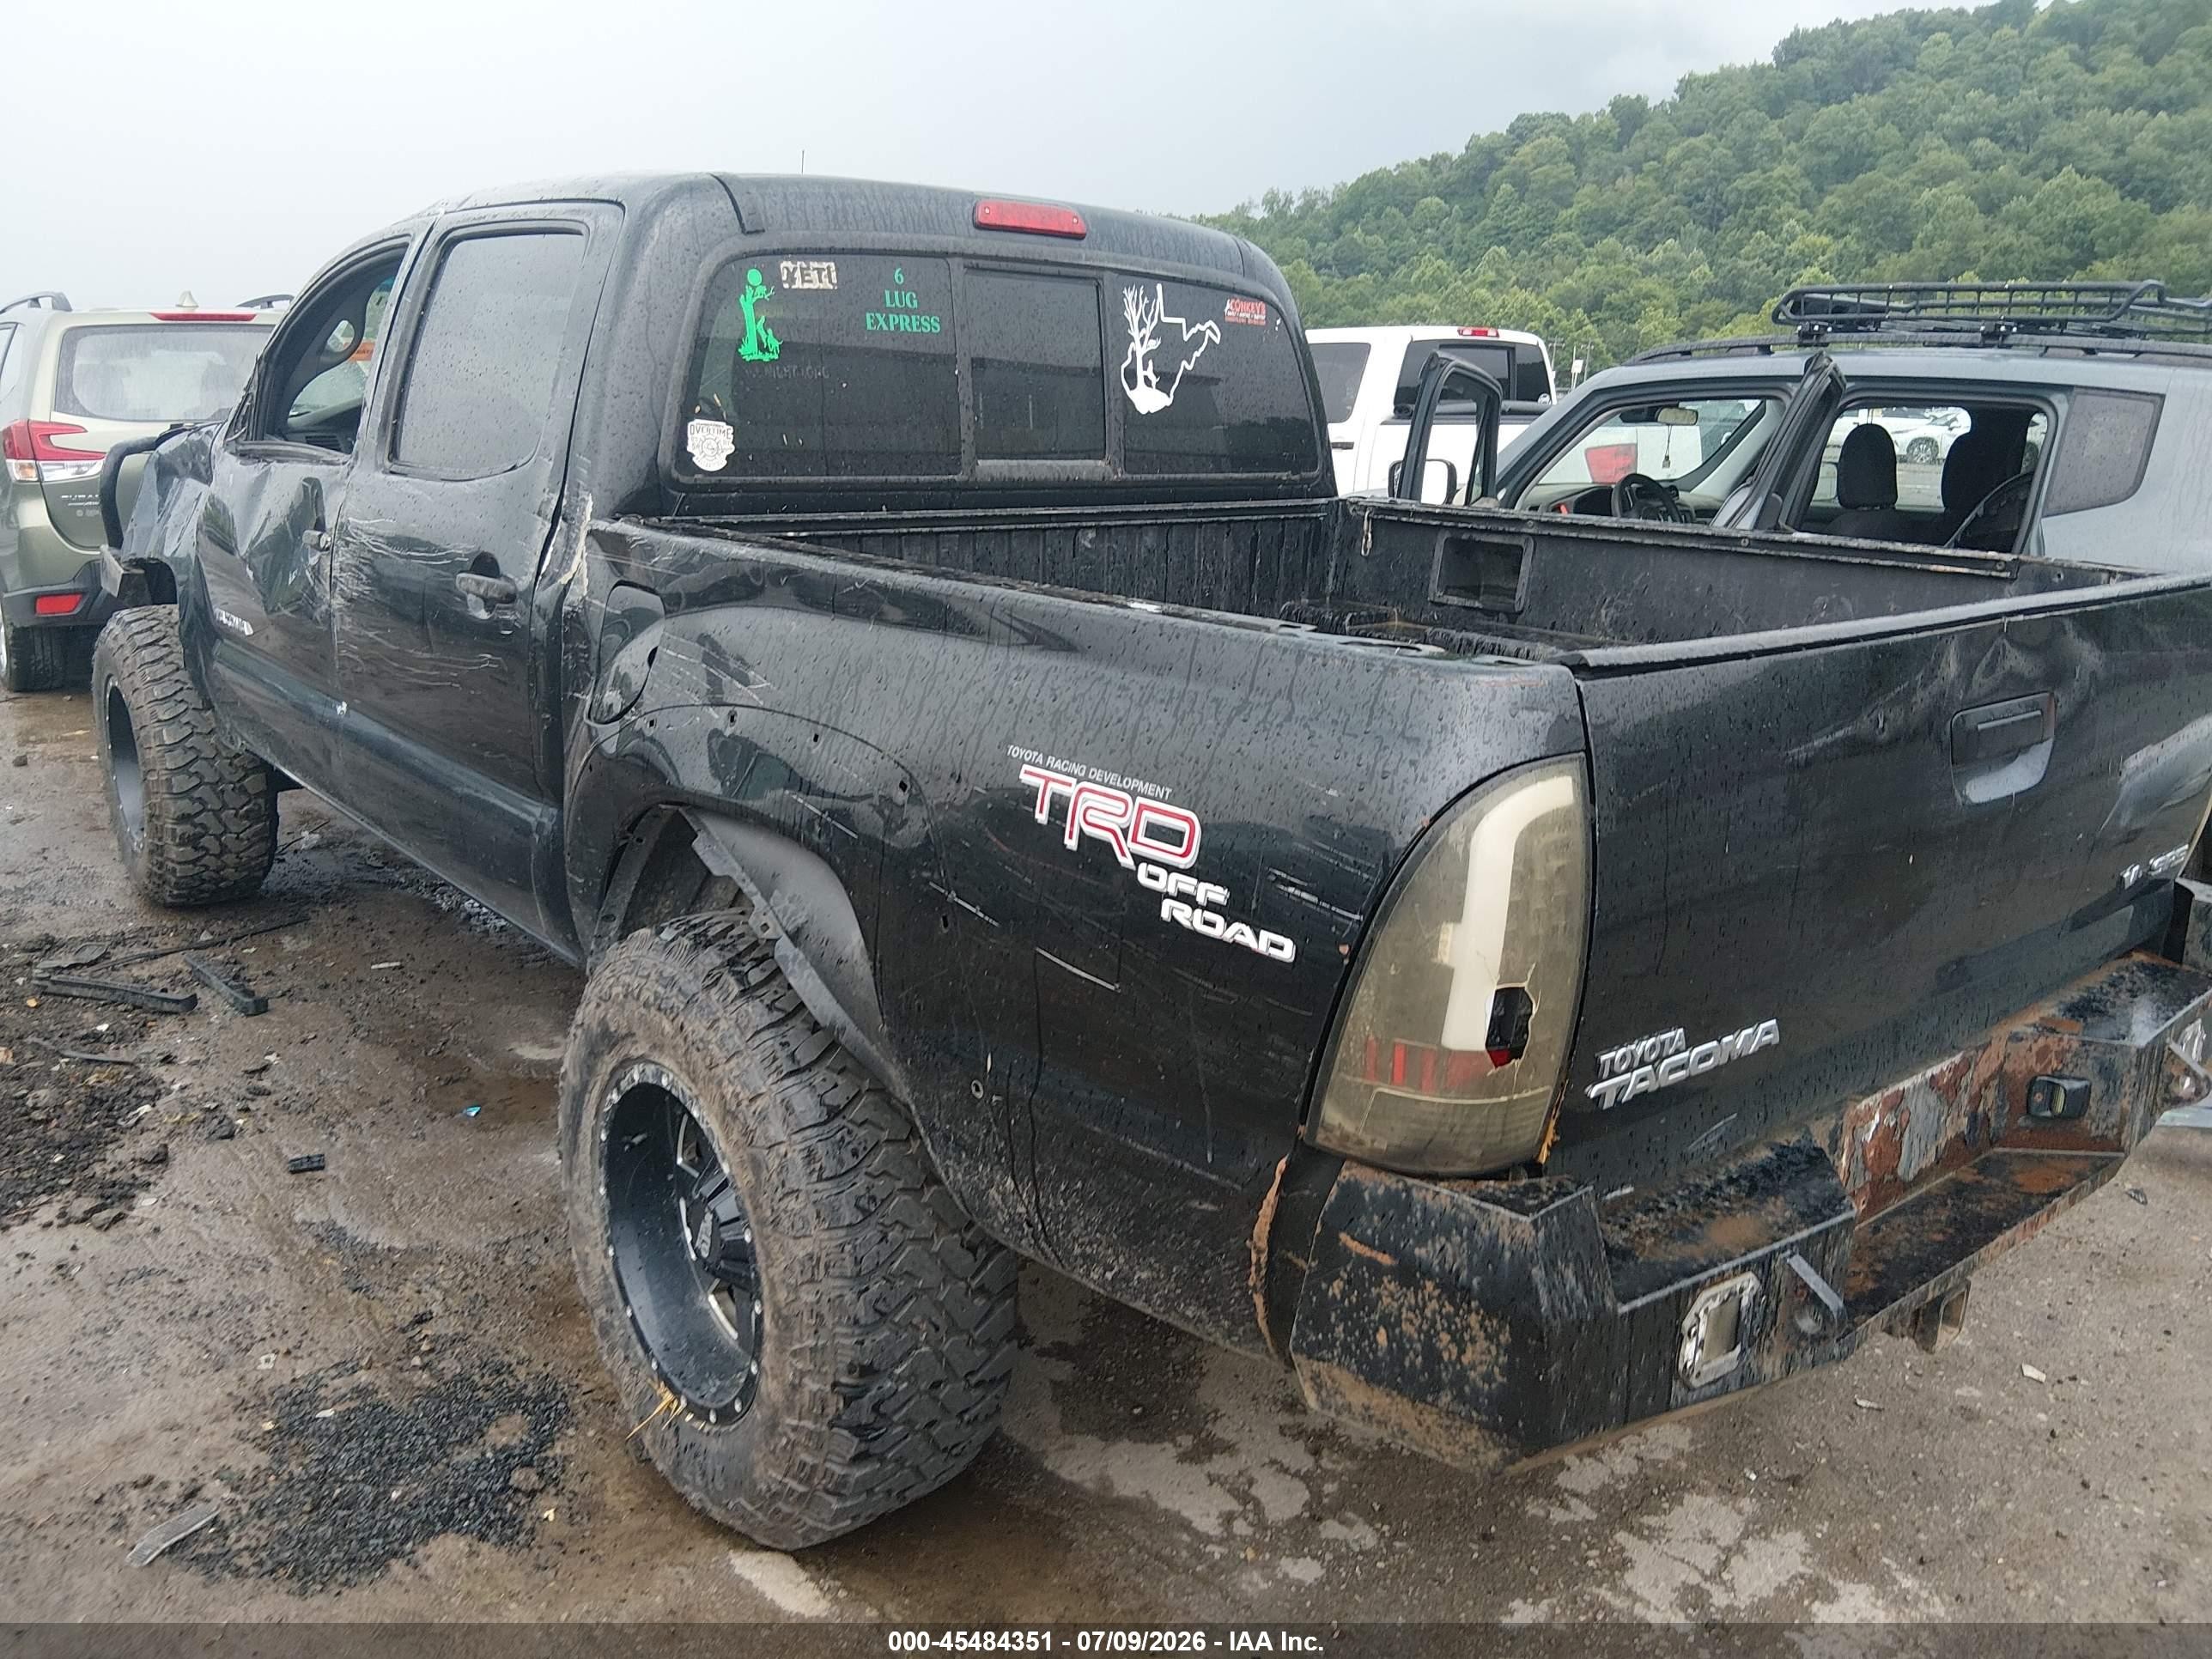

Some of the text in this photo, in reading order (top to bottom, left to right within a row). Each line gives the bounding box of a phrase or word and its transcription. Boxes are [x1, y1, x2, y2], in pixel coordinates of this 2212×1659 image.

[781, 263, 836, 288] YETI
[884, 289, 918, 309] LUG
[893, 267, 904, 284] 6
[866, 313, 940, 333] EXPRESS
[1006, 744, 1173, 800] TOYOTA RACING DEVELOPMENT
[1019, 763, 1202, 871] TRD
[1137, 861, 1231, 907] OFF
[1161, 898, 1296, 963] ROAD
[1584, 1018, 1780, 1110] TACOMA
[1595, 1027, 1686, 1079] TOYOTA
